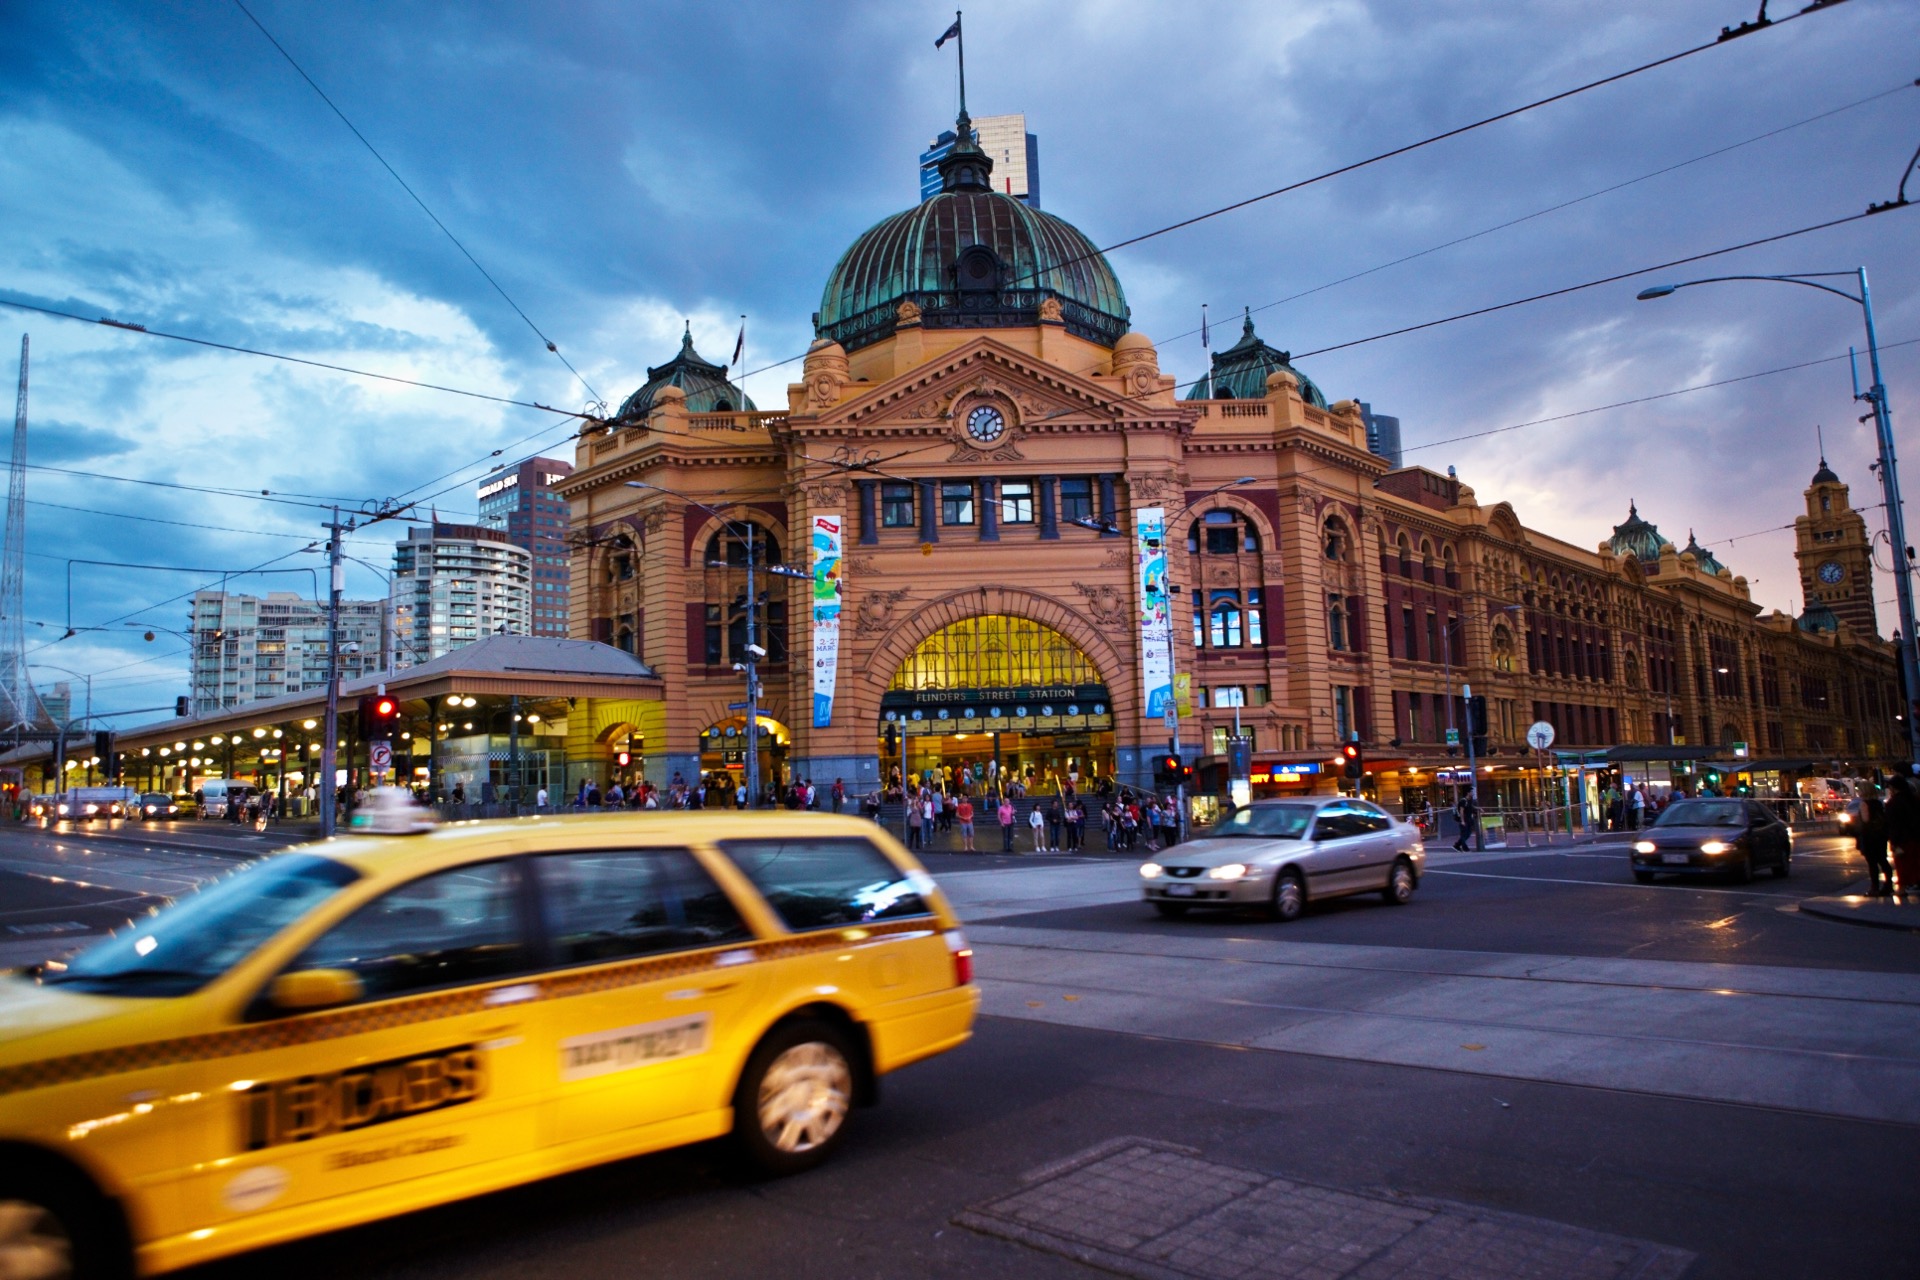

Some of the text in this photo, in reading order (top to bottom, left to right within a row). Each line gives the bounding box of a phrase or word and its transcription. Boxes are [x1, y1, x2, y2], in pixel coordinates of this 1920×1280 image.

[503, 474, 518, 489] SUN
[456, 527, 506, 542] QUAY WEST
[916, 689, 1075, 702] FLINDERS STREET STATION
